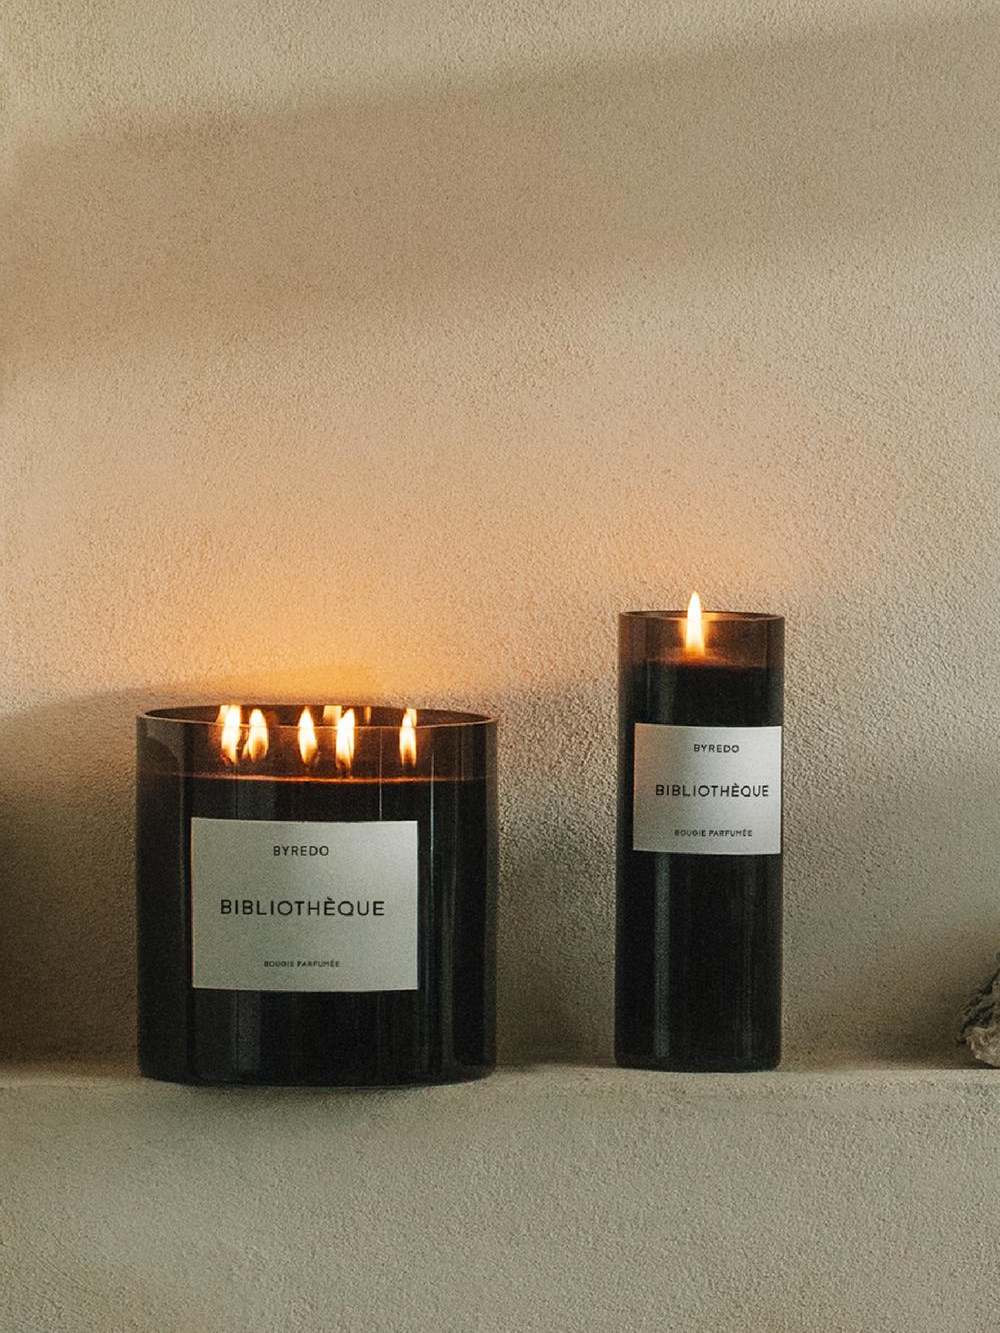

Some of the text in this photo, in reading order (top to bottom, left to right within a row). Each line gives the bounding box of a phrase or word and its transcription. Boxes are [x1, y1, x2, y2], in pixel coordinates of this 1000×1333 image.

[693, 744, 740, 753] BYREDO
[655, 783, 769, 797] BIBLIOTHÈQUE
[674, 829, 706, 837] BOUGIE
[273, 845, 329, 856] BYREDO
[220, 897, 385, 916] BIBLIOTHÈQUE
[263, 960, 294, 968] BOUGIE
